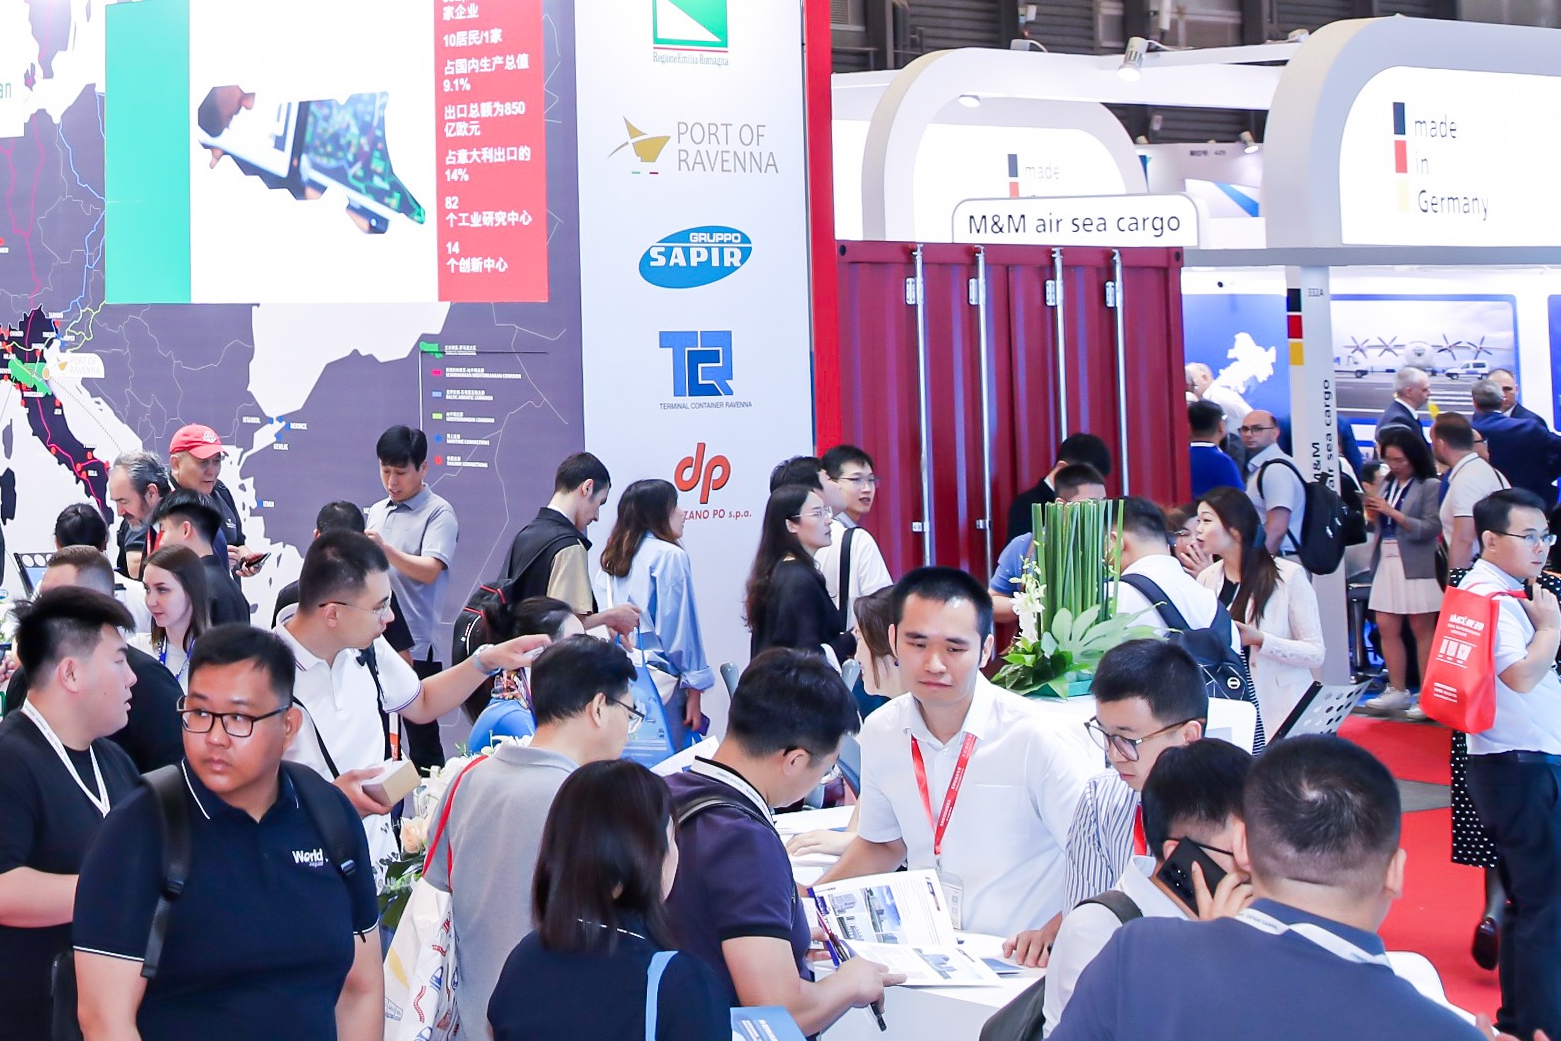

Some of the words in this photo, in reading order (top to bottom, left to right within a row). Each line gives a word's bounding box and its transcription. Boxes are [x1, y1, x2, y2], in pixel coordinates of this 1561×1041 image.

[442, 4, 479, 21] 家企业
[444, 53, 530, 75] 占国内生产总值
[443, 78, 471, 93] 9.1%
[444, 120, 480, 138] 亿欧元
[677, 121, 733, 145] PORT
[739, 123, 766, 146] OF
[1414, 113, 1457, 139] made
[445, 145, 531, 165] 占意大利出口的
[677, 148, 779, 174] RAVENNA
[1415, 150, 1429, 175] in
[445, 169, 469, 182] 14%
[1025, 161, 1060, 180] made
[445, 196, 458, 209] 82
[1418, 189, 1489, 222] Germany
[445, 209, 532, 228] 个工业研究中心
[968, 214, 1026, 234] M&M
[1035, 212, 1063, 233] air
[1071, 217, 1107, 233] sea
[1116, 215, 1181, 237] cargo
[689, 232, 741, 244] GRUPPO
[446, 242, 460, 254] 14
[649, 246, 742, 267] SAPIR
[446, 257, 508, 274] 个创新中心
[659, 402, 690, 410] TERMINAL
[725, 401, 753, 409] RAVENNA
[1323, 379, 1333, 427] cargo
[674, 442, 731, 504] dp
[713, 509, 726, 519] PO
[728, 509, 752, 520] s.p.a.
[291, 848, 324, 863] World
